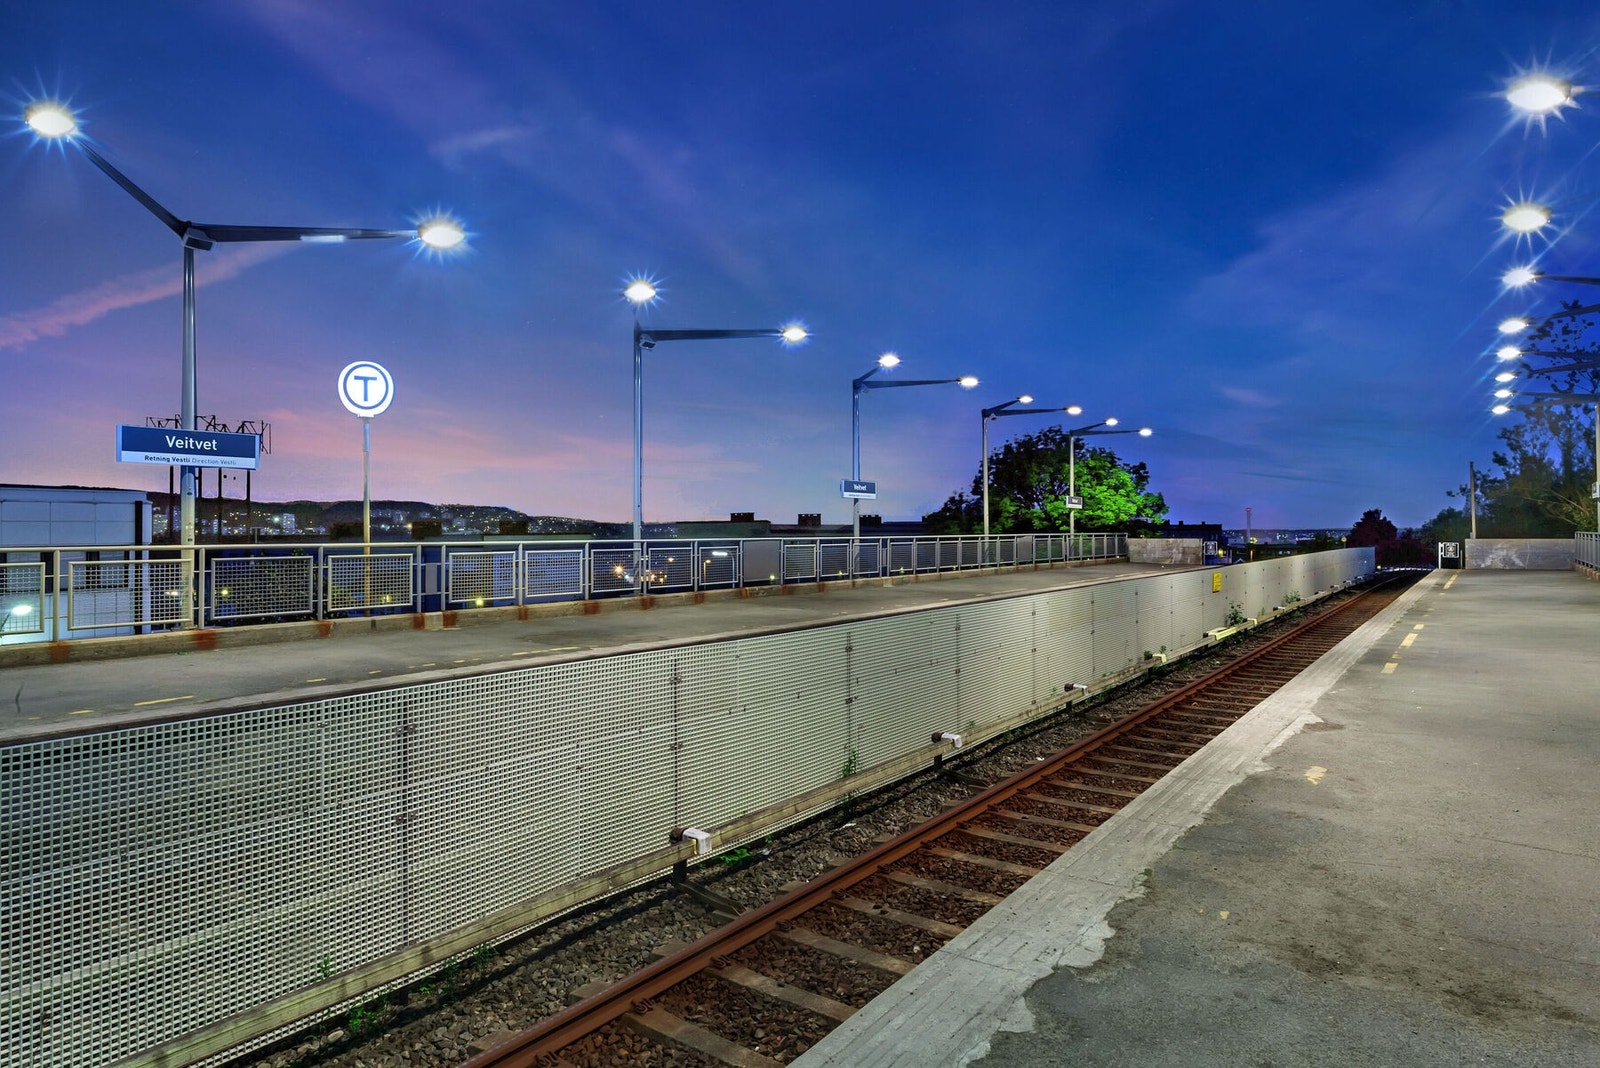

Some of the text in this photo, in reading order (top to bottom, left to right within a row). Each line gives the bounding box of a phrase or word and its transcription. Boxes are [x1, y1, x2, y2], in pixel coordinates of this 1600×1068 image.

[354, 375, 377, 402] T
[165, 435, 217, 451] Veitvet
[144, 455, 171, 463] Retning
[191, 457, 219, 465] Direction
